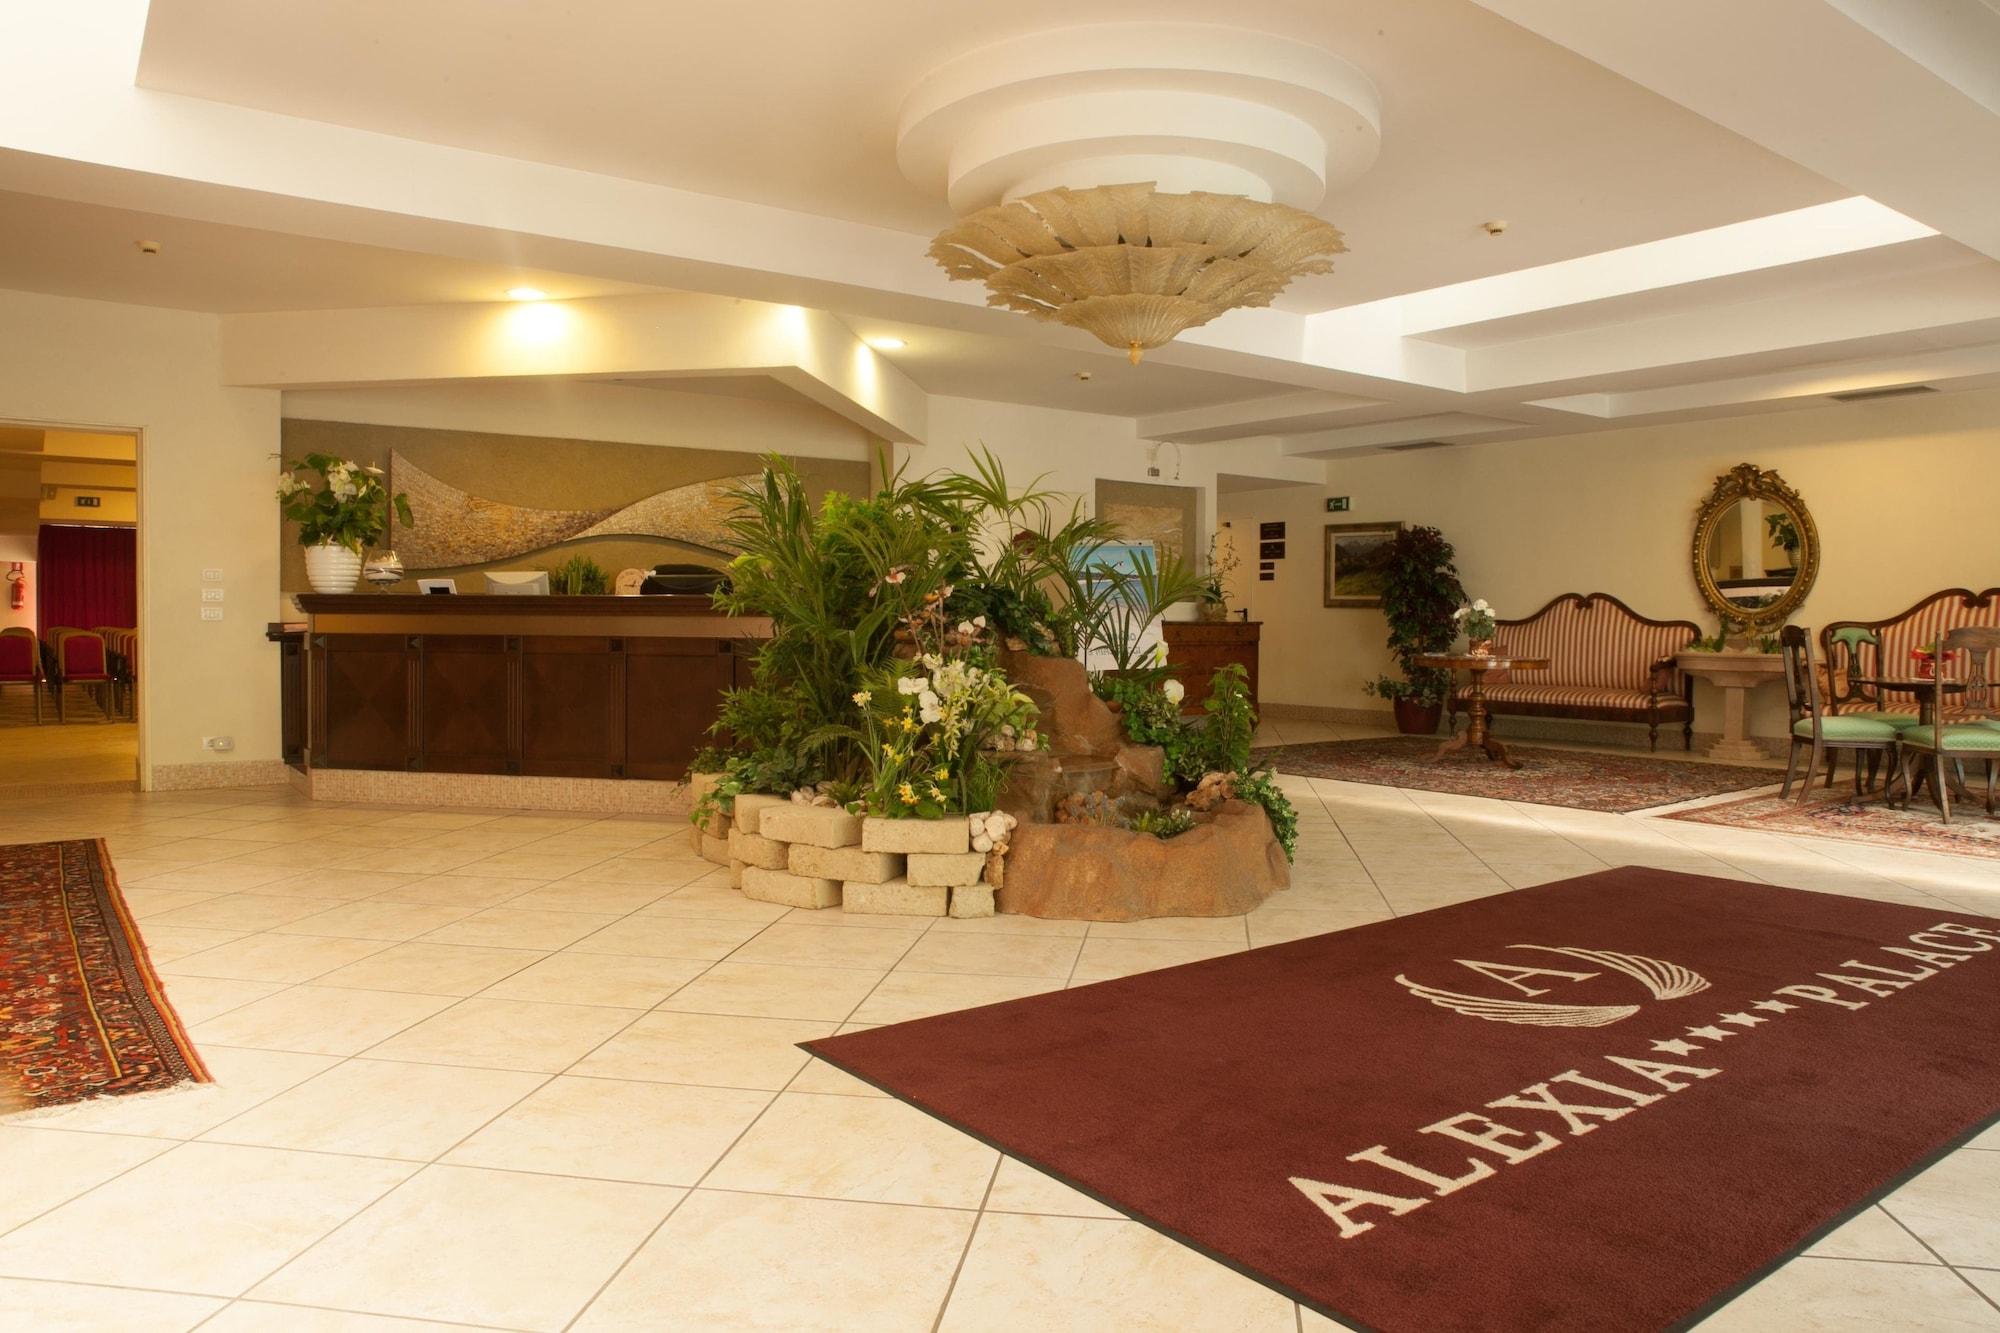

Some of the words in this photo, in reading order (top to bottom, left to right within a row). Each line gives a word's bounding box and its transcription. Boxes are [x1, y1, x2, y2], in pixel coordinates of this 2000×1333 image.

[1453, 959, 1601, 997] A
[1288, 1054, 1723, 1239] ALEXIA
[1773, 922, 2000, 1011] PALACE
